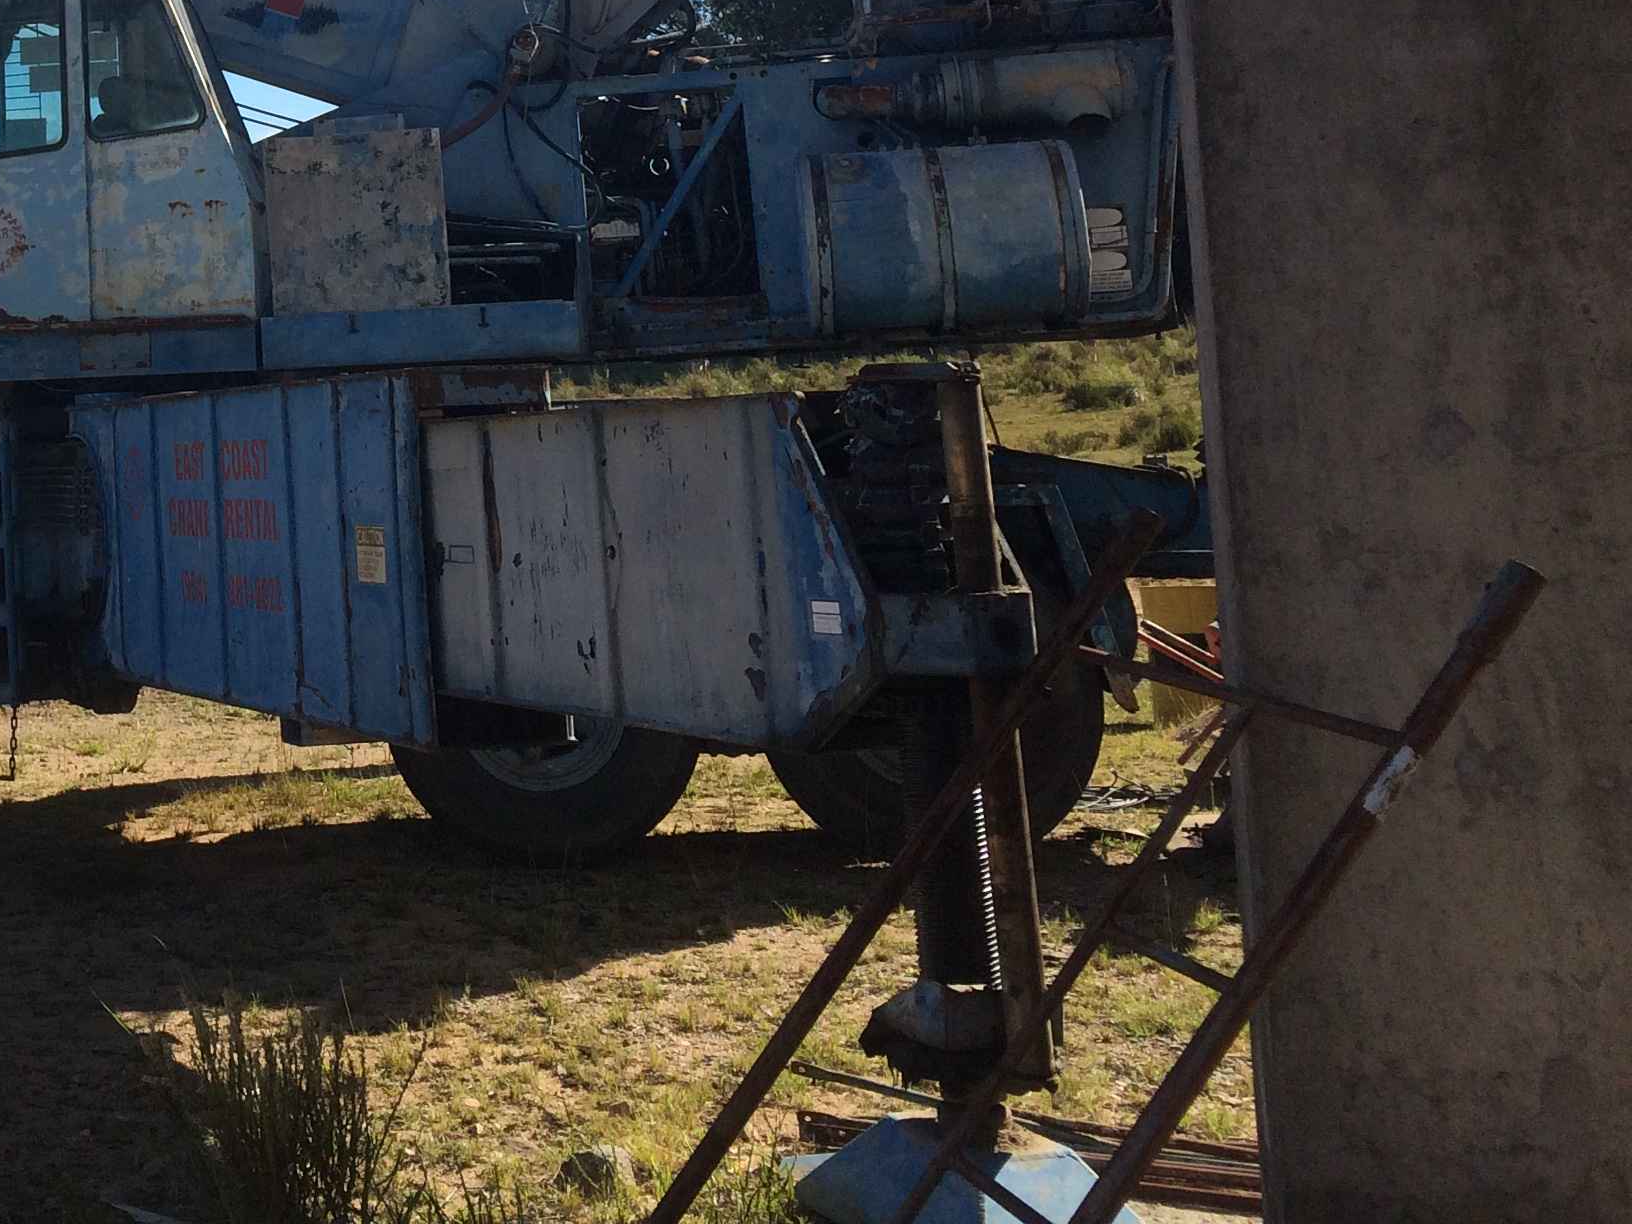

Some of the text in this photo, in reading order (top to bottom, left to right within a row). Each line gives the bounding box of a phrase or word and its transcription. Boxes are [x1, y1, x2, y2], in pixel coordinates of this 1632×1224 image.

[174, 439, 269, 481] EAST COAST
[223, 498, 280, 544] RENTAL
